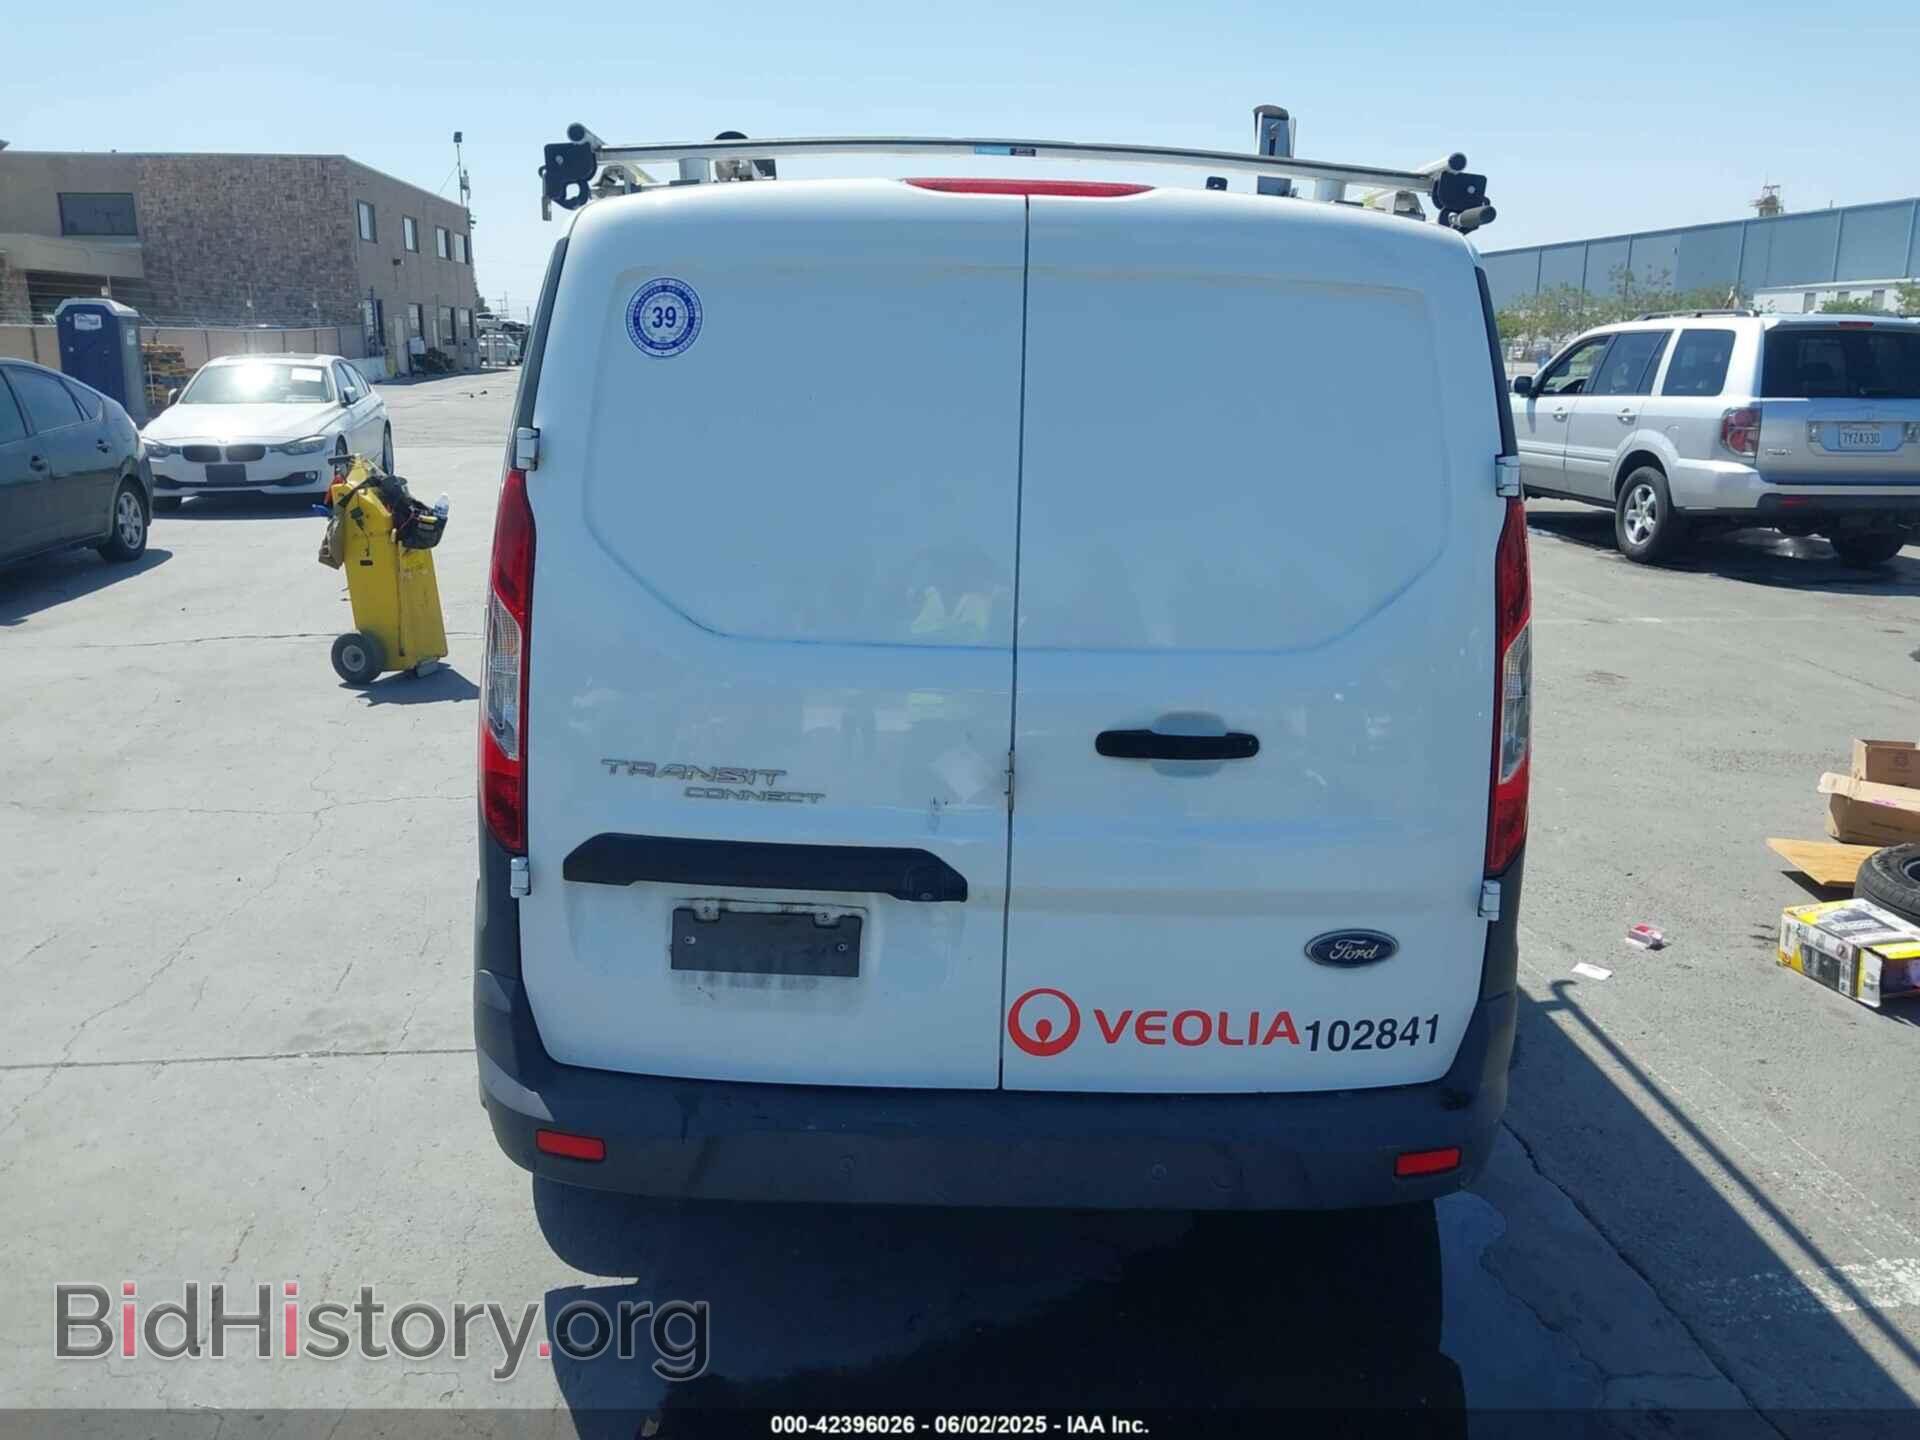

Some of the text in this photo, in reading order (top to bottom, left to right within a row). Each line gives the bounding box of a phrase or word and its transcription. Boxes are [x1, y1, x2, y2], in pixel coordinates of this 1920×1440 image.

[652, 306, 677, 329] 39
[601, 759, 786, 786] TRANSIT
[684, 787, 826, 804] CONNECT
[1329, 939, 1378, 960] Ford
[1093, 1010, 1440, 1052] VEOLIA 102841
